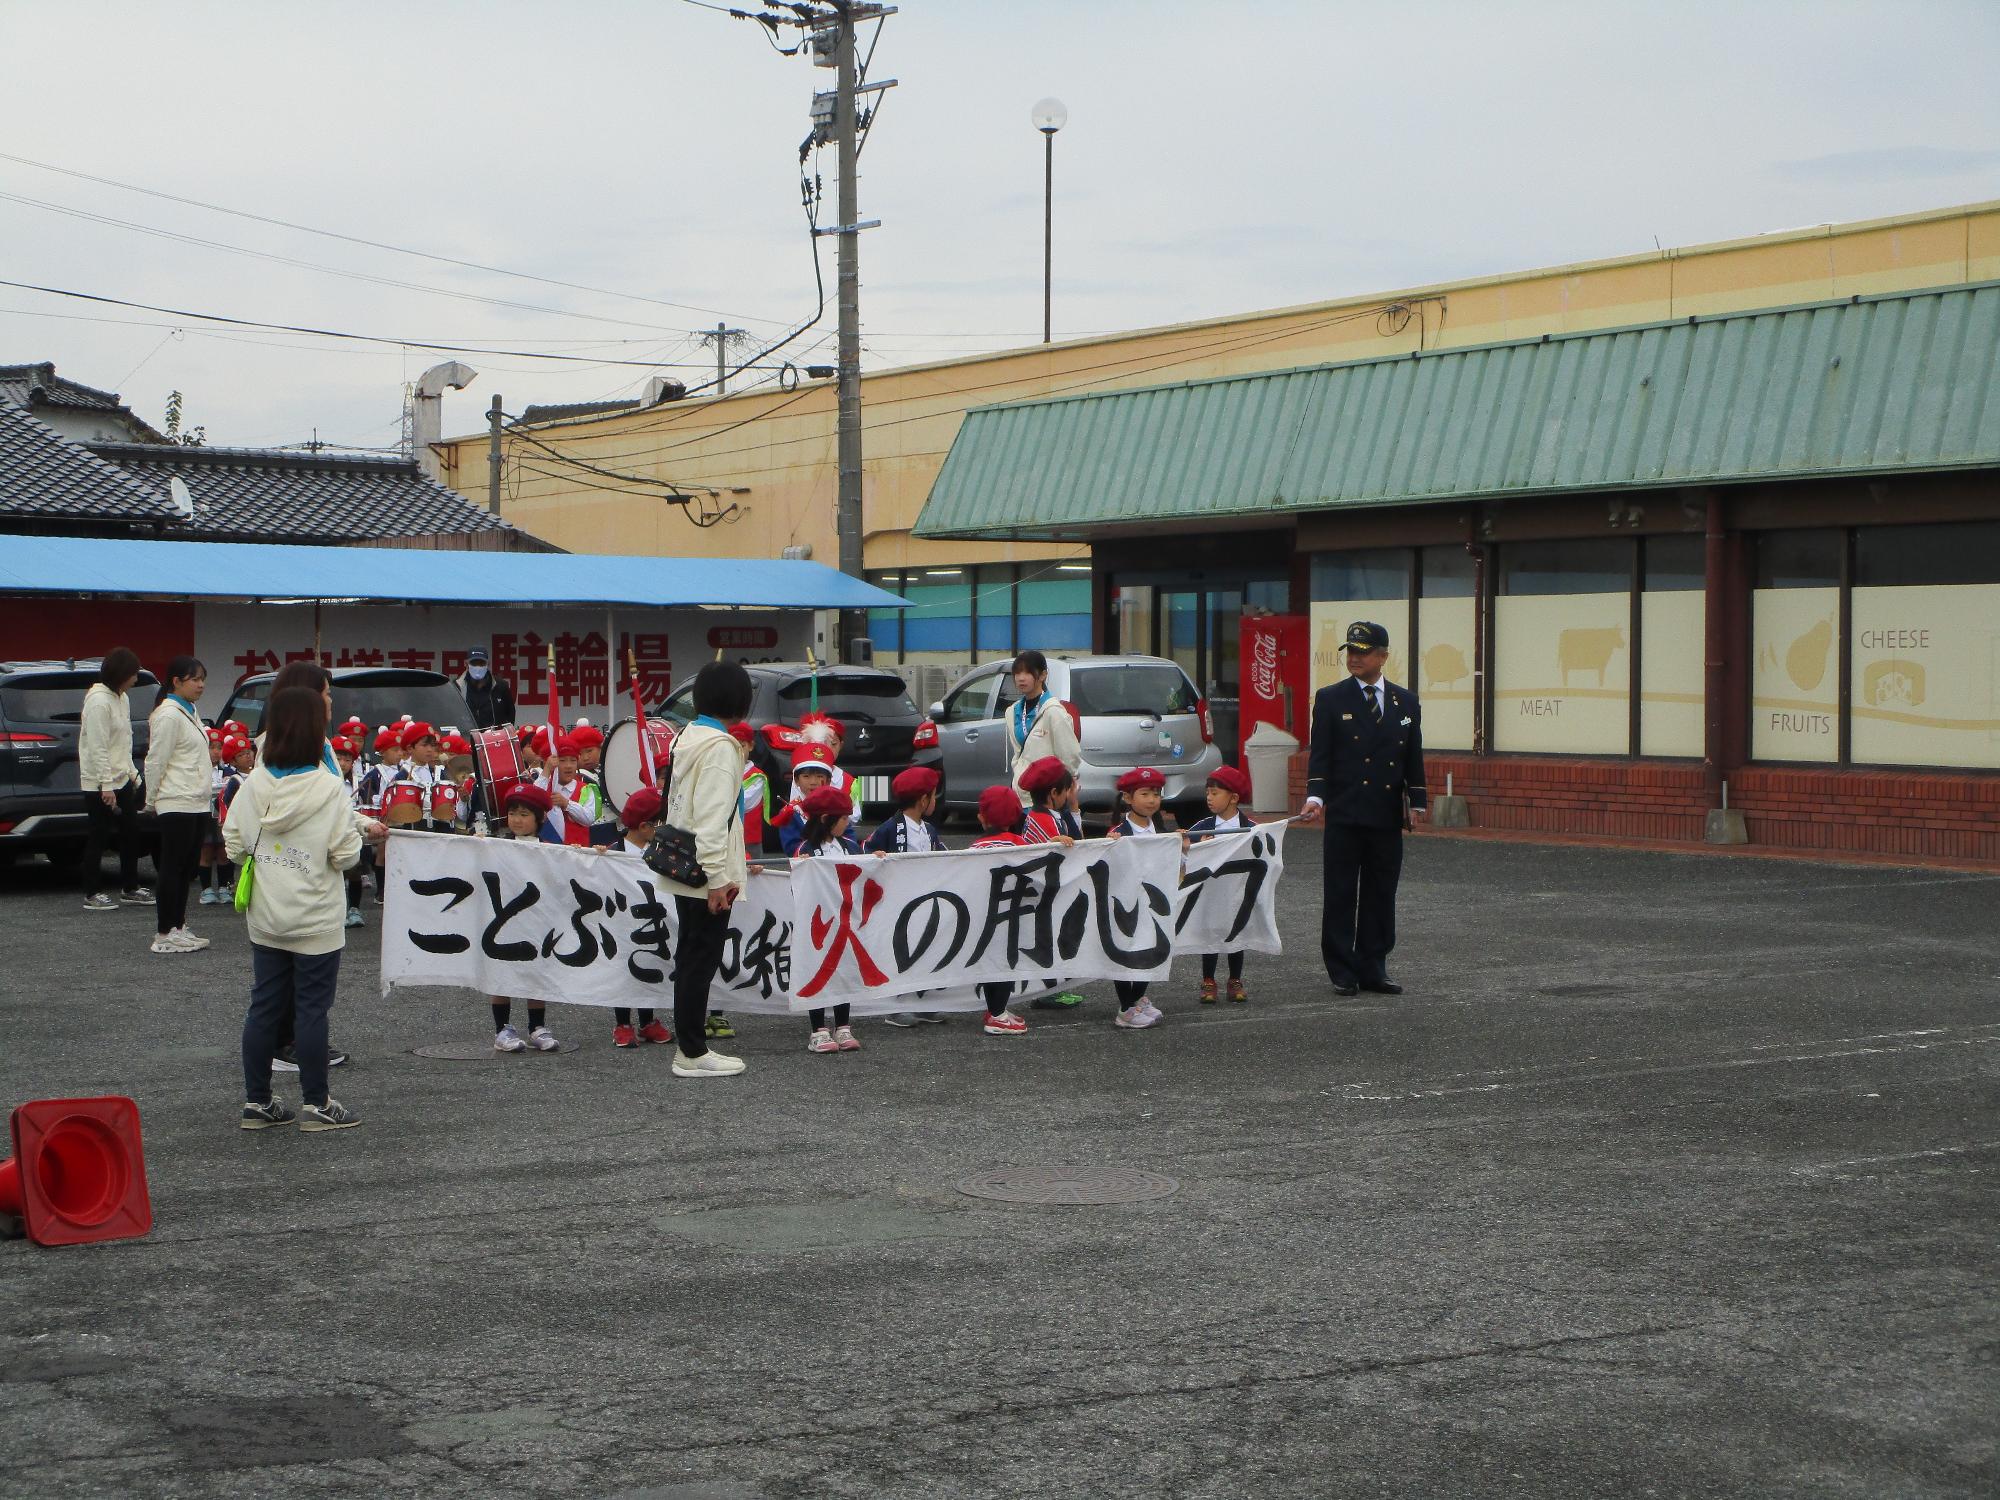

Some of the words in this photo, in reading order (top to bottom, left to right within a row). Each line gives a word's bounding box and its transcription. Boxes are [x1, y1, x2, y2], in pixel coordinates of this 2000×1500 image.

[1860, 629, 1930, 650] CHEESE
[1253, 631, 1278, 700] Coca-Cola
[1312, 651, 1344, 668] MILK
[1519, 699, 1562, 718] MEAT
[1771, 713, 1831, 735] FRUITS
[796, 851, 1172, 998] 火の用心
